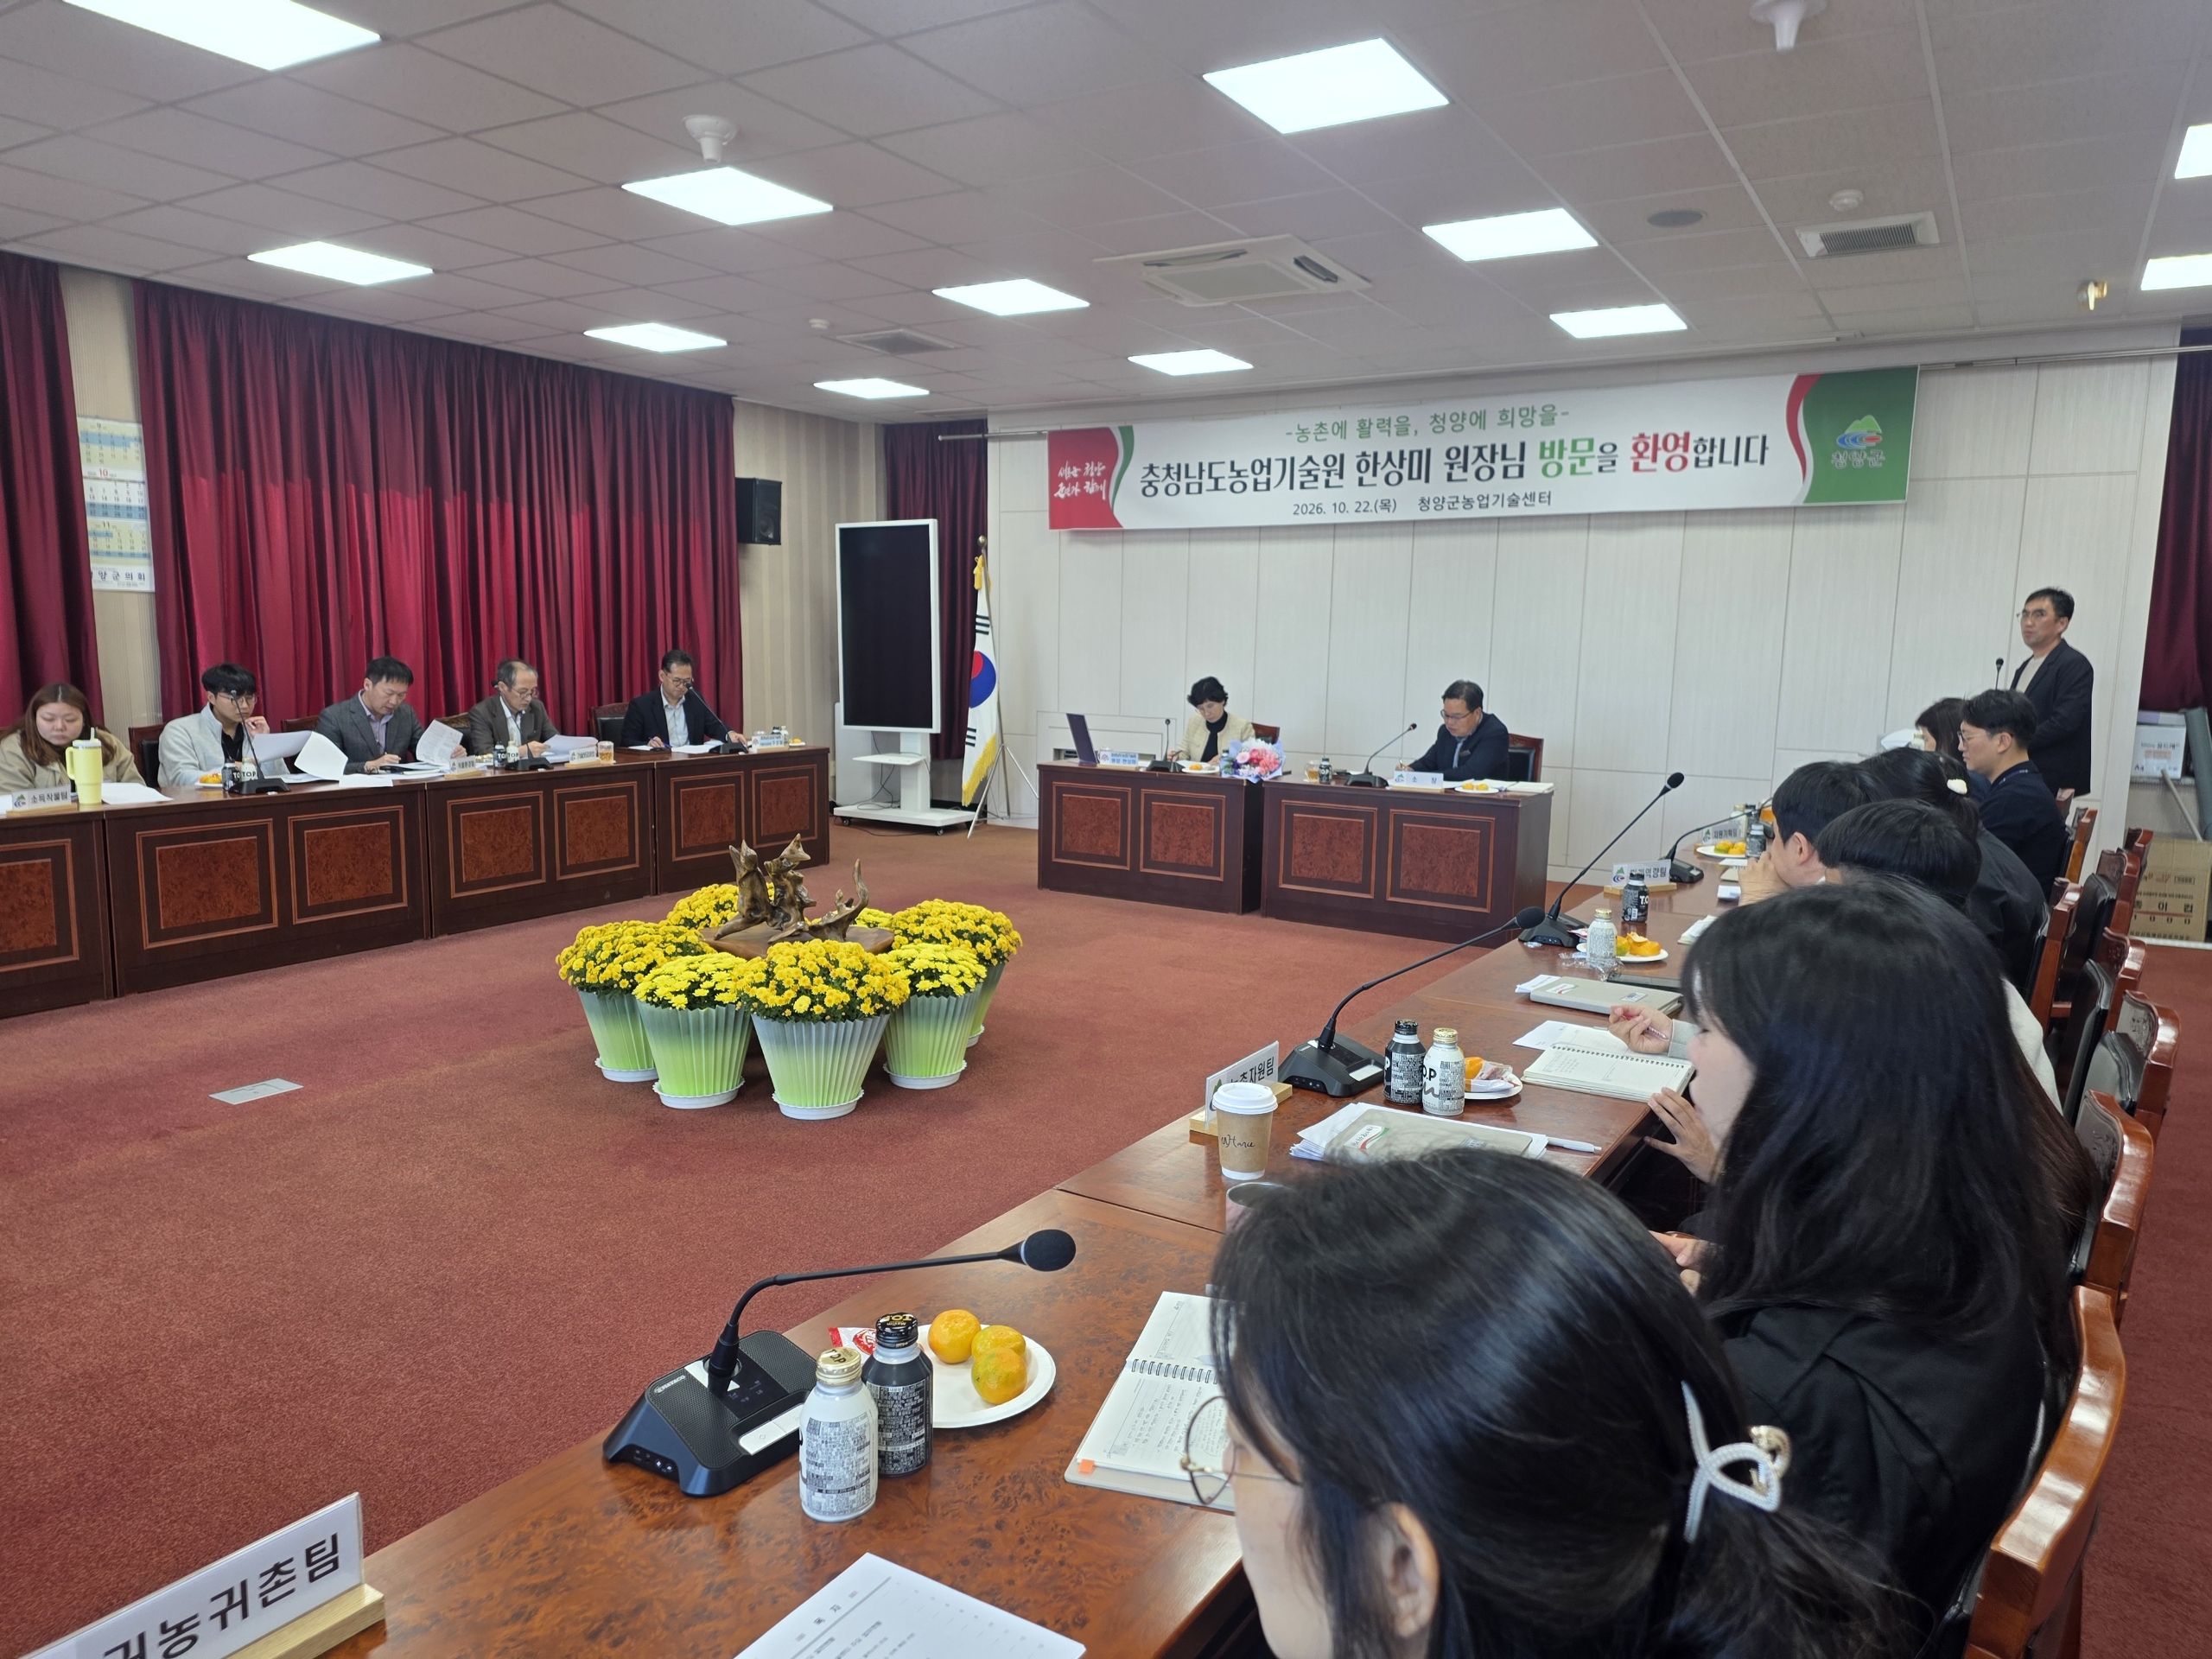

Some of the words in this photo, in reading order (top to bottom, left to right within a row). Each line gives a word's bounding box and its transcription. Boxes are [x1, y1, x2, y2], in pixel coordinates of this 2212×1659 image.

[1356, 415, 1418, 439] 활력을,
[1429, 409, 1487, 434] 청양에
[99, 467, 108, 476] 10
[1140, 453, 1344, 498] 충청남도농업기술원
[1356, 448, 1431, 486] 한상미
[1444, 441, 1526, 482] 원장님
[1539, 437, 1618, 479] 방문을
[1630, 430, 1769, 473] 환영합니다
[1831, 450, 1885, 469] 청양군
[1293, 503, 1325, 516] 2026.
[1332, 501, 1349, 514] 10.
[1354, 498, 1397, 513] 22.(목)
[1418, 490, 1552, 512] 청양군농업기술센터
[31, 791, 67, 804] 소득작물팀
[102, 1533, 340, 1659] 귀농귀촌팀
